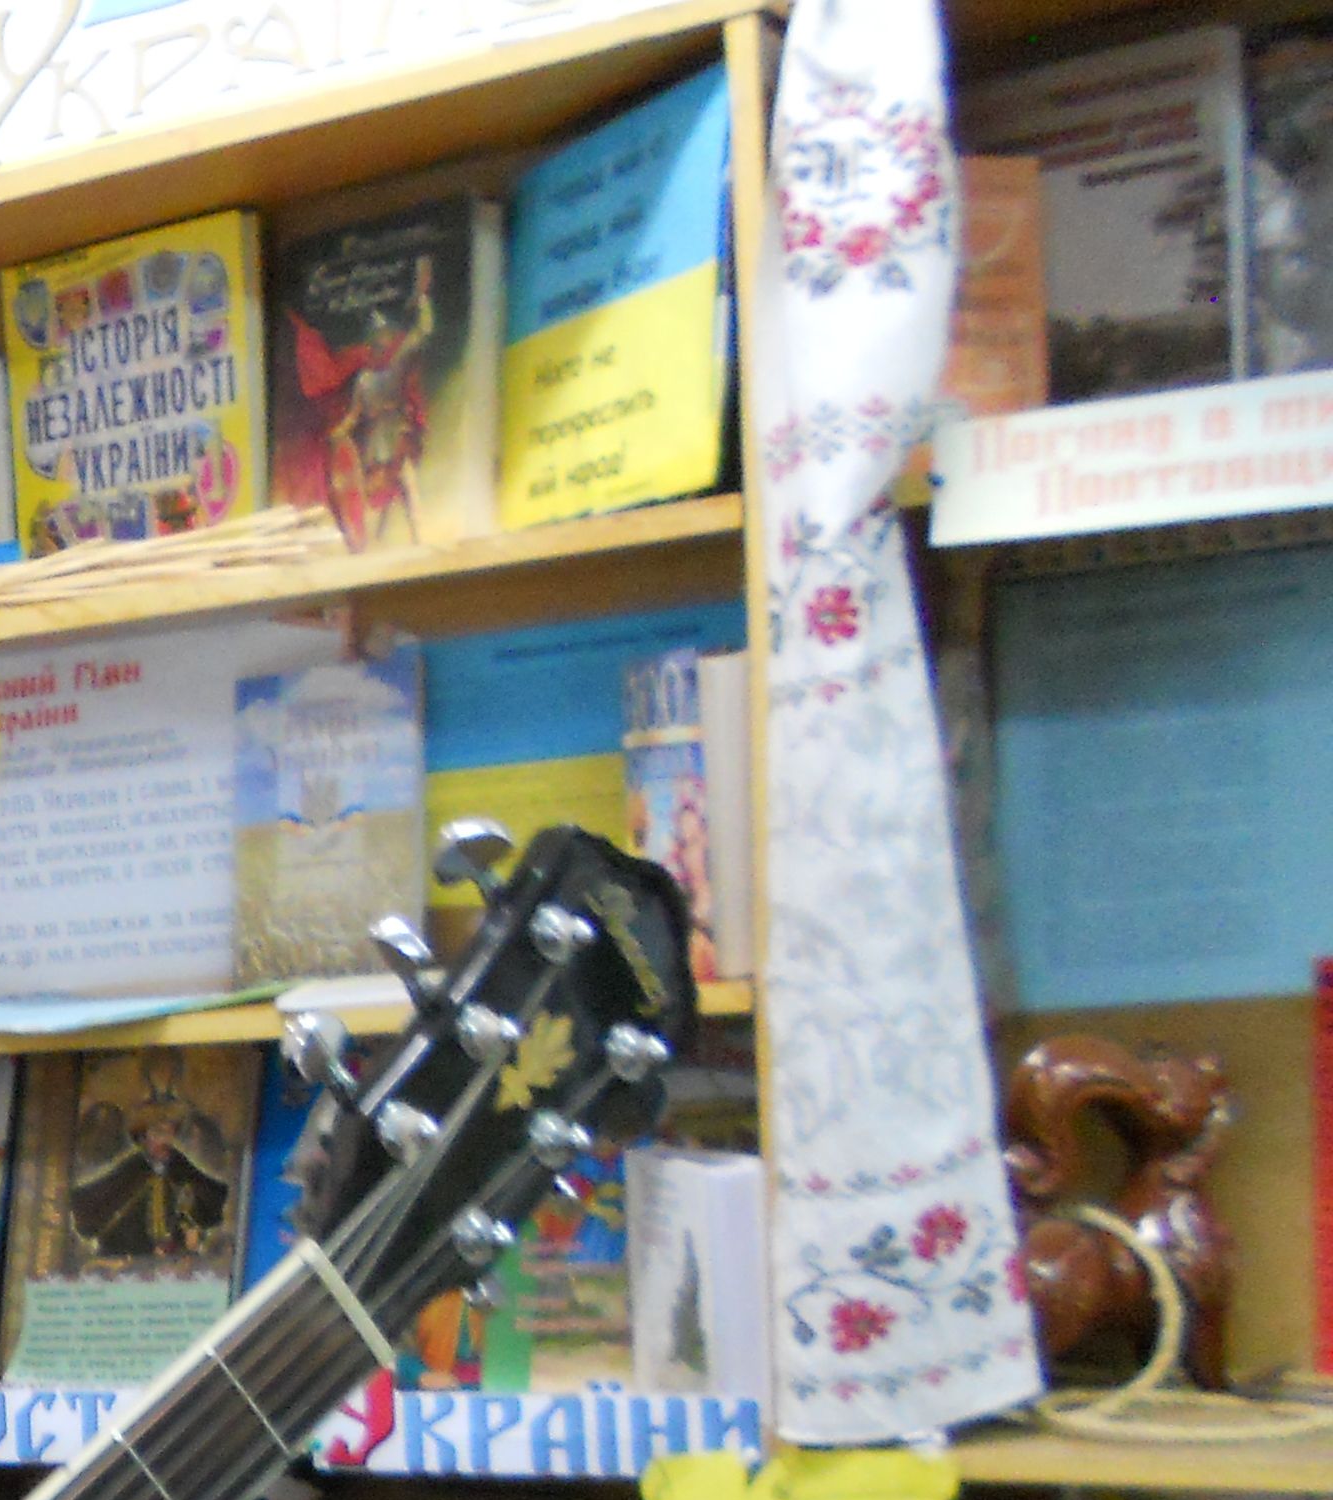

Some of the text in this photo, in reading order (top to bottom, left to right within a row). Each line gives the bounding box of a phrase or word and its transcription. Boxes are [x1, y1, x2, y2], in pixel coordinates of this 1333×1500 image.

[70, 308, 180, 375] ІСТОРІЯ
[26, 357, 235, 446] НЕЗАЛЕЖНОСТІ
[73, 430, 190, 494] УКРАЇНИ
[326, 1366, 761, 1475] УКРАЇНИ
